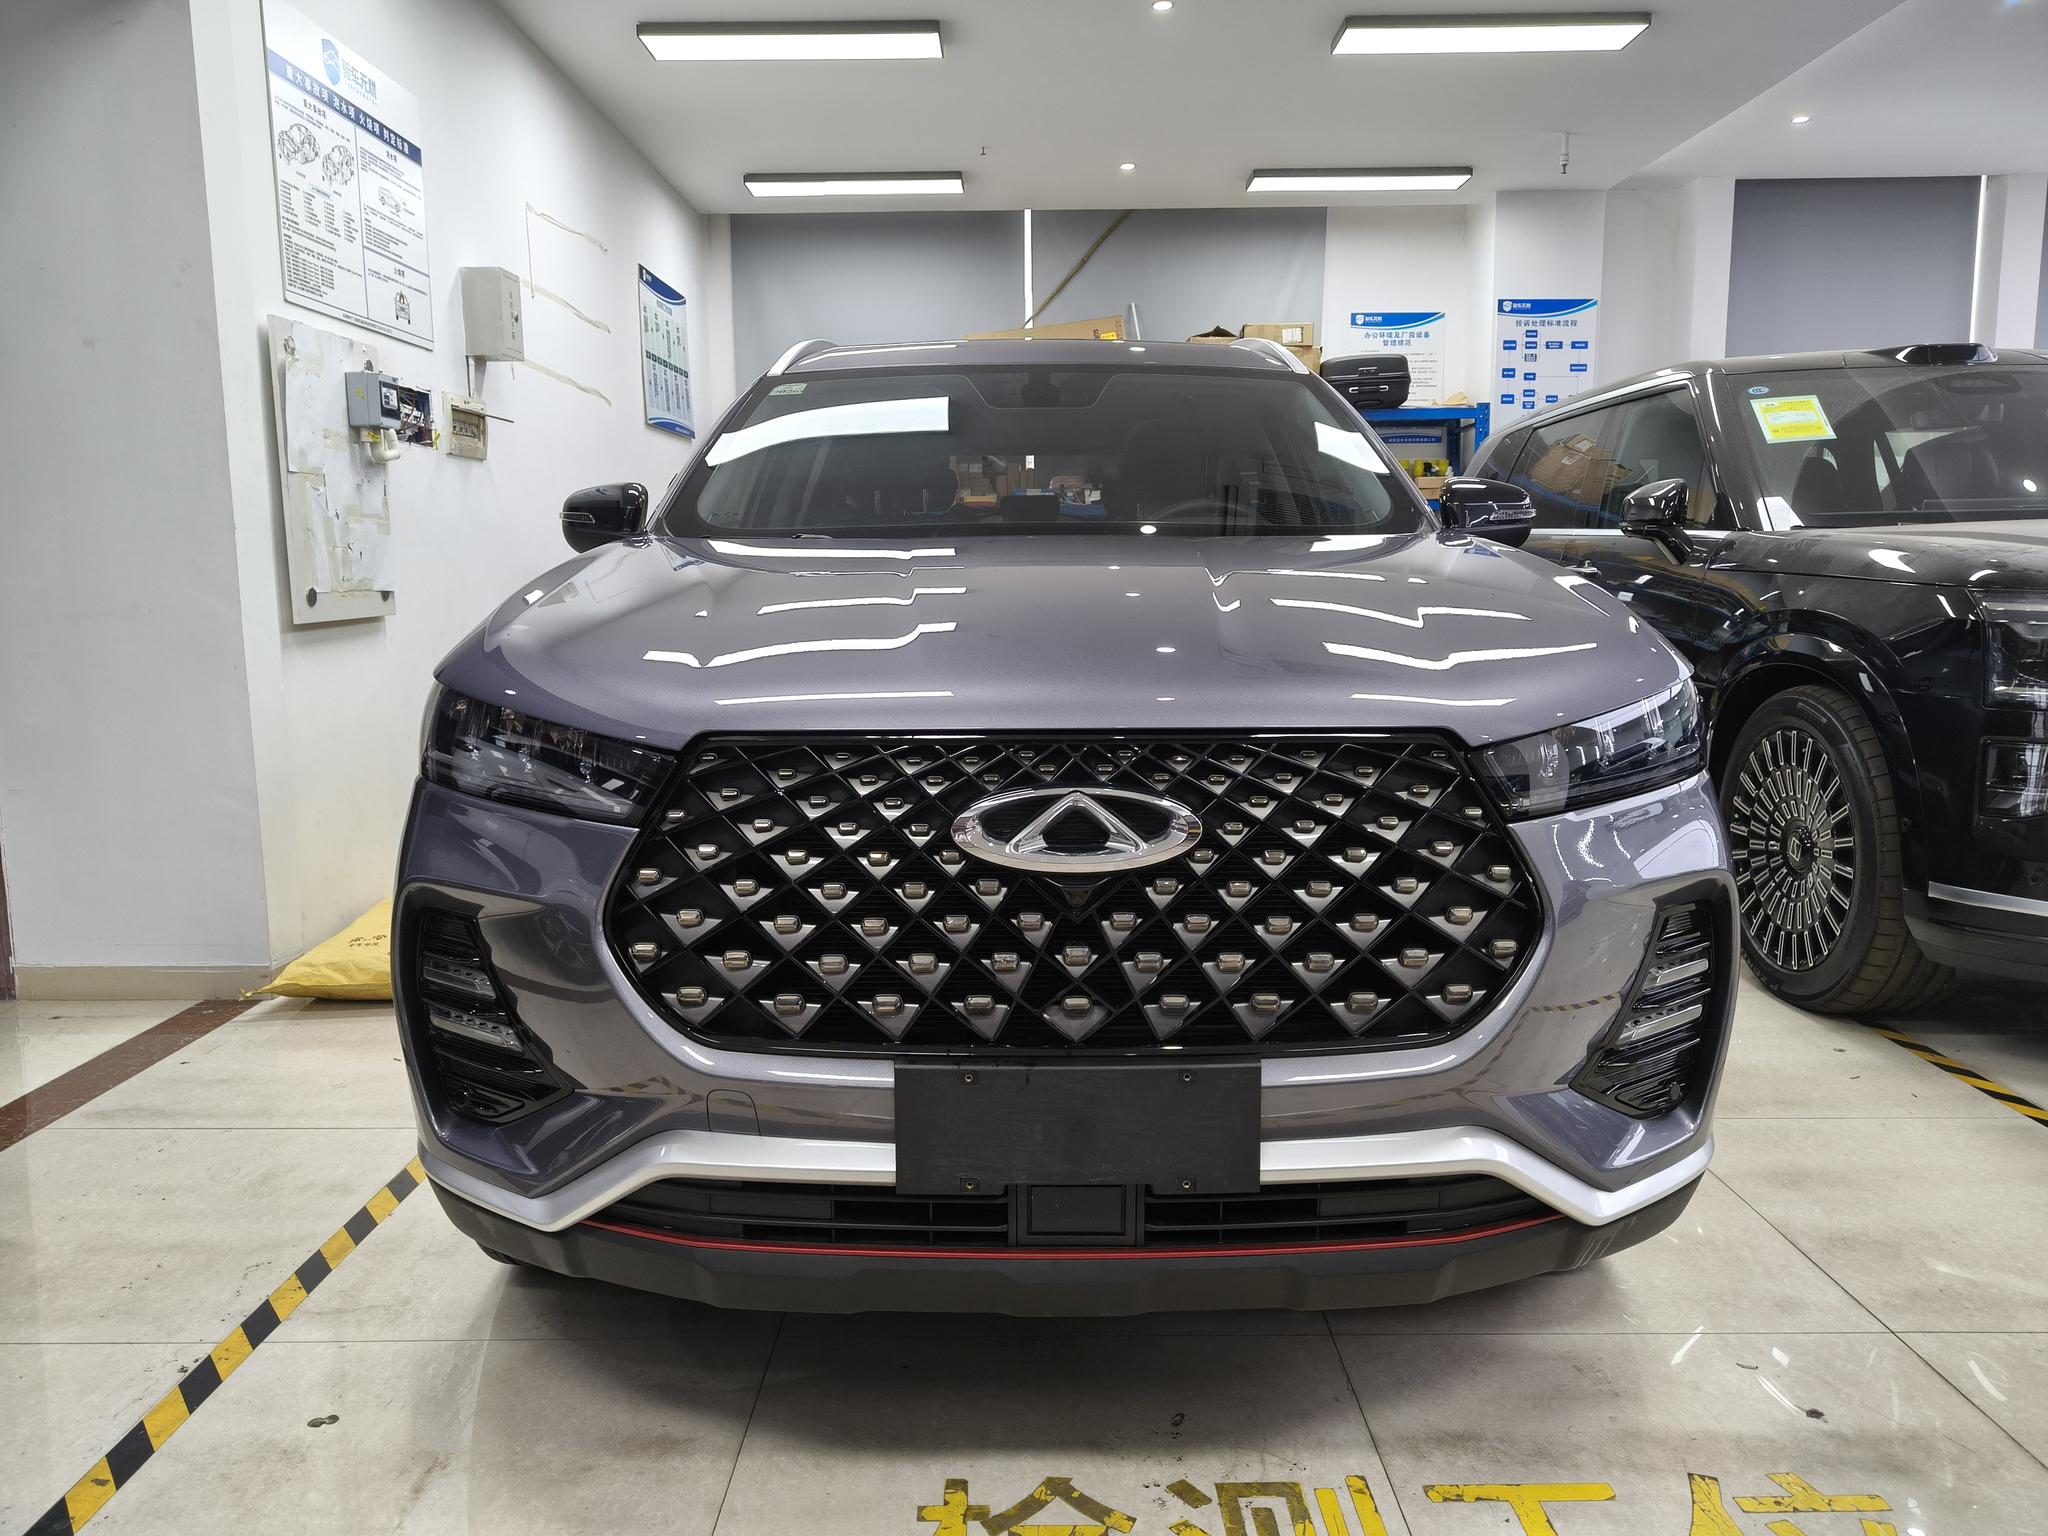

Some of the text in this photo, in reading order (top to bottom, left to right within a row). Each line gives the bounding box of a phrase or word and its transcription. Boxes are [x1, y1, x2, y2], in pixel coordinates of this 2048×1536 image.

[286, 64, 330, 103] 重大事故项
[333, 94, 356, 121] 泡水项
[383, 127, 409, 154] 判定标准
